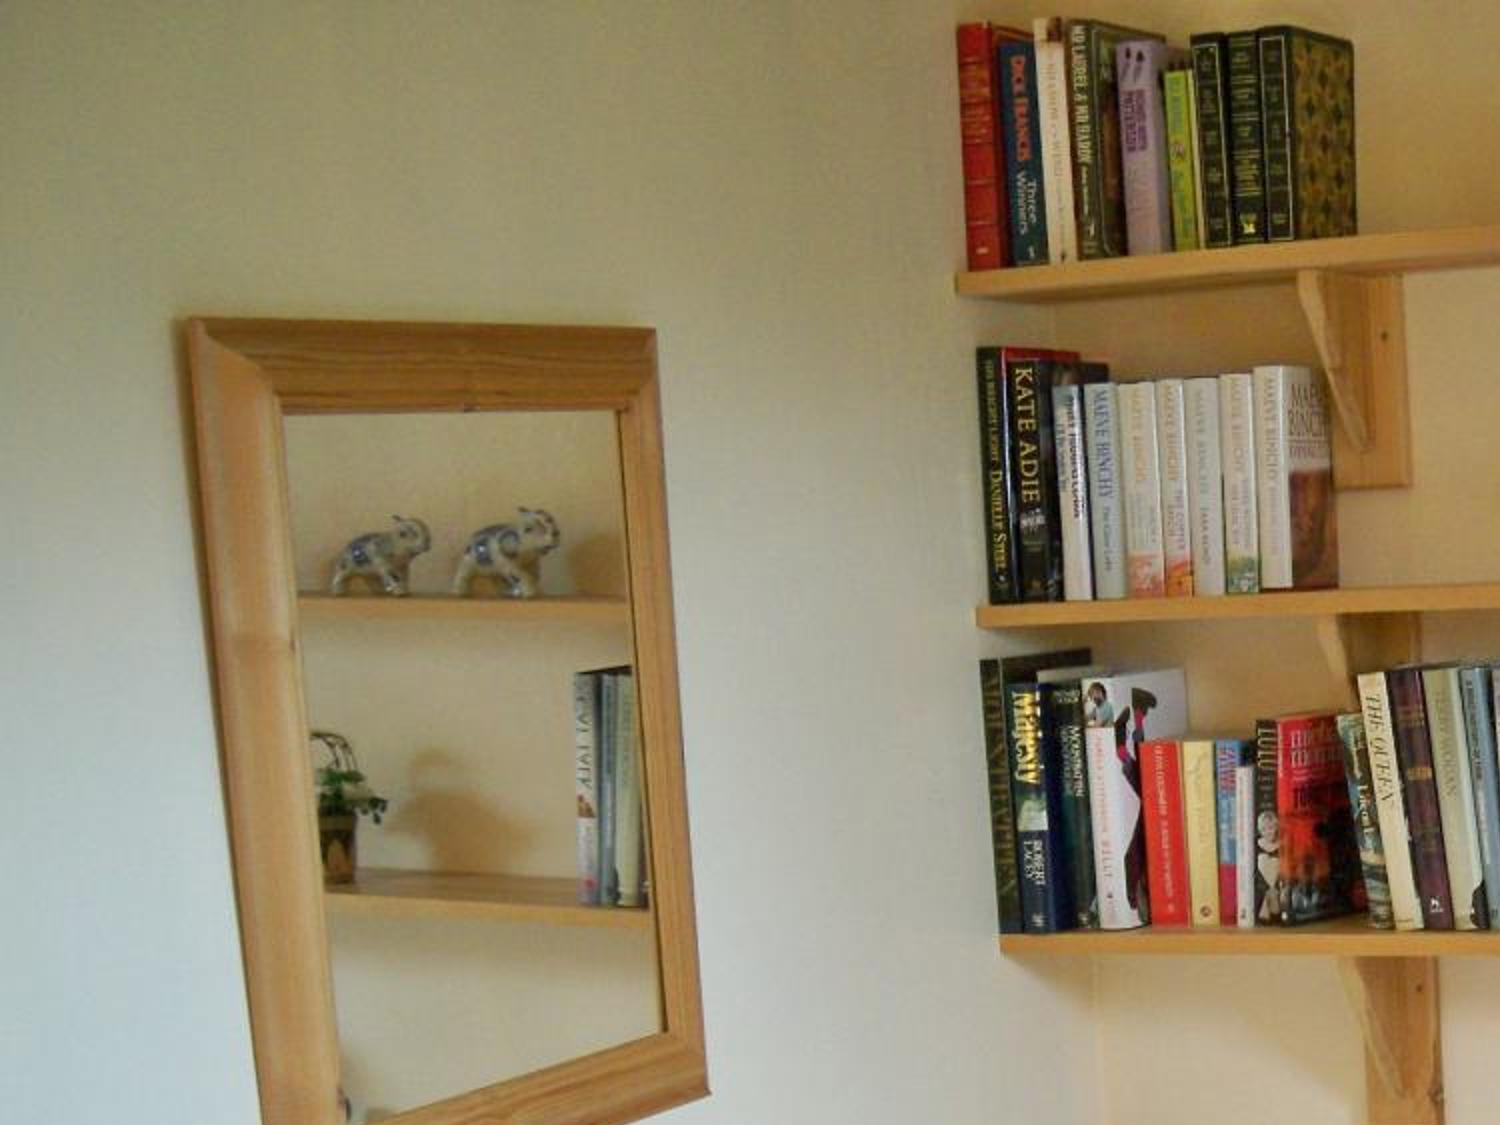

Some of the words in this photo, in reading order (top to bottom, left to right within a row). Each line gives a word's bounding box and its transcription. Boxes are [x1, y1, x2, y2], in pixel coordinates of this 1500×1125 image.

[1074, 45, 1088, 91] LAUREL
[1076, 125, 1092, 164] HARDY
[1016, 171, 1029, 235] Winners
[1027, 179, 1037, 224] Three
[1015, 367, 1039, 433] KATE
[1093, 390, 1113, 441] MAEVE
[1019, 441, 1041, 504] ADIE
[1096, 443, 1114, 499] BINCHY
[989, 470, 1003, 529] DANIELLE
[993, 533, 1006, 571] STEEL
[1011, 690, 1043, 785] Majesty
[1365, 694, 1384, 730] THE
[1068, 725, 1084, 797] MOUNTBATTEN
[1257, 727, 1278, 770] LULU
[1370, 736, 1394, 802] QUEEN
[1022, 839, 1035, 880] LACEY
[1032, 839, 1046, 885] ROBERT
